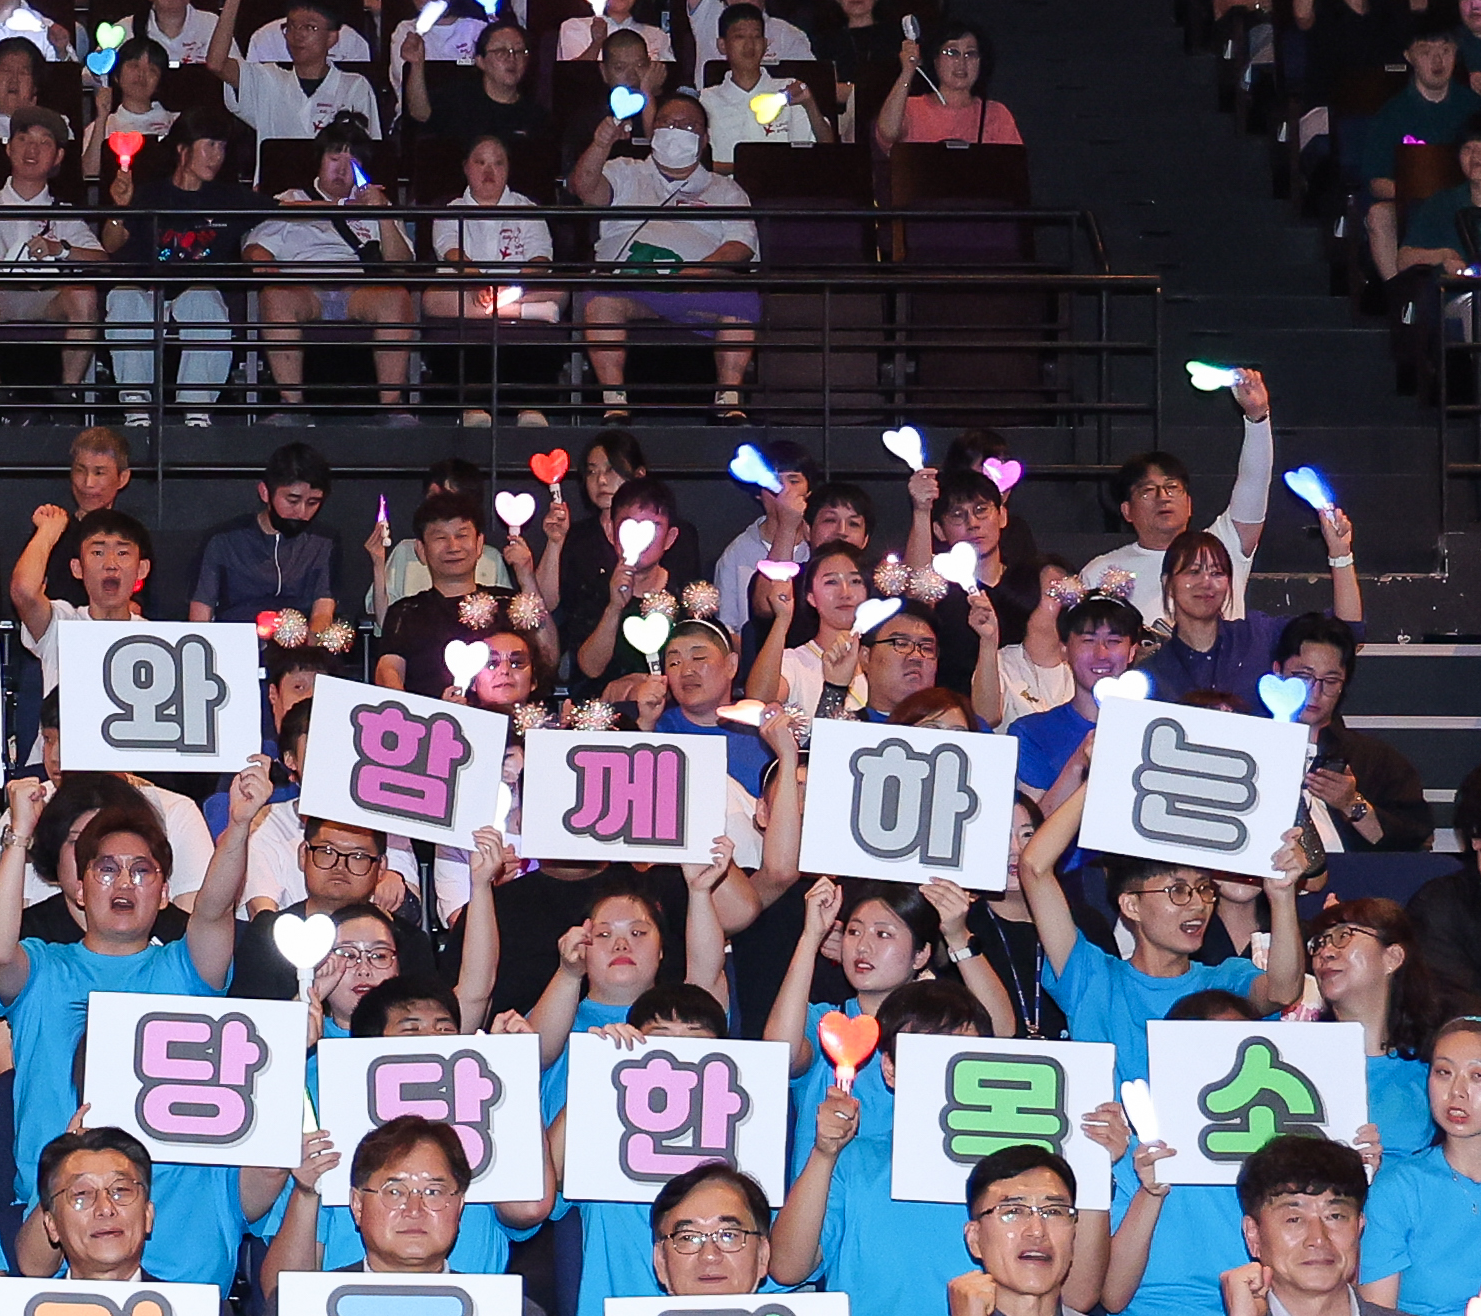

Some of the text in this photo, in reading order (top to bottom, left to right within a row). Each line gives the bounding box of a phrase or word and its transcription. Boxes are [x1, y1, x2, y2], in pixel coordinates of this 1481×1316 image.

[101, 632, 230, 753] 와
[350, 699, 472, 827] 함
[562, 743, 686, 847] 께
[849, 738, 978, 867] 하
[1131, 717, 1259, 853] 는
[134, 1012, 268, 1144] 당
[612, 1050, 749, 1179] 한
[939, 1052, 1074, 1162] 목
[1198, 1036, 1326, 1156] 소
